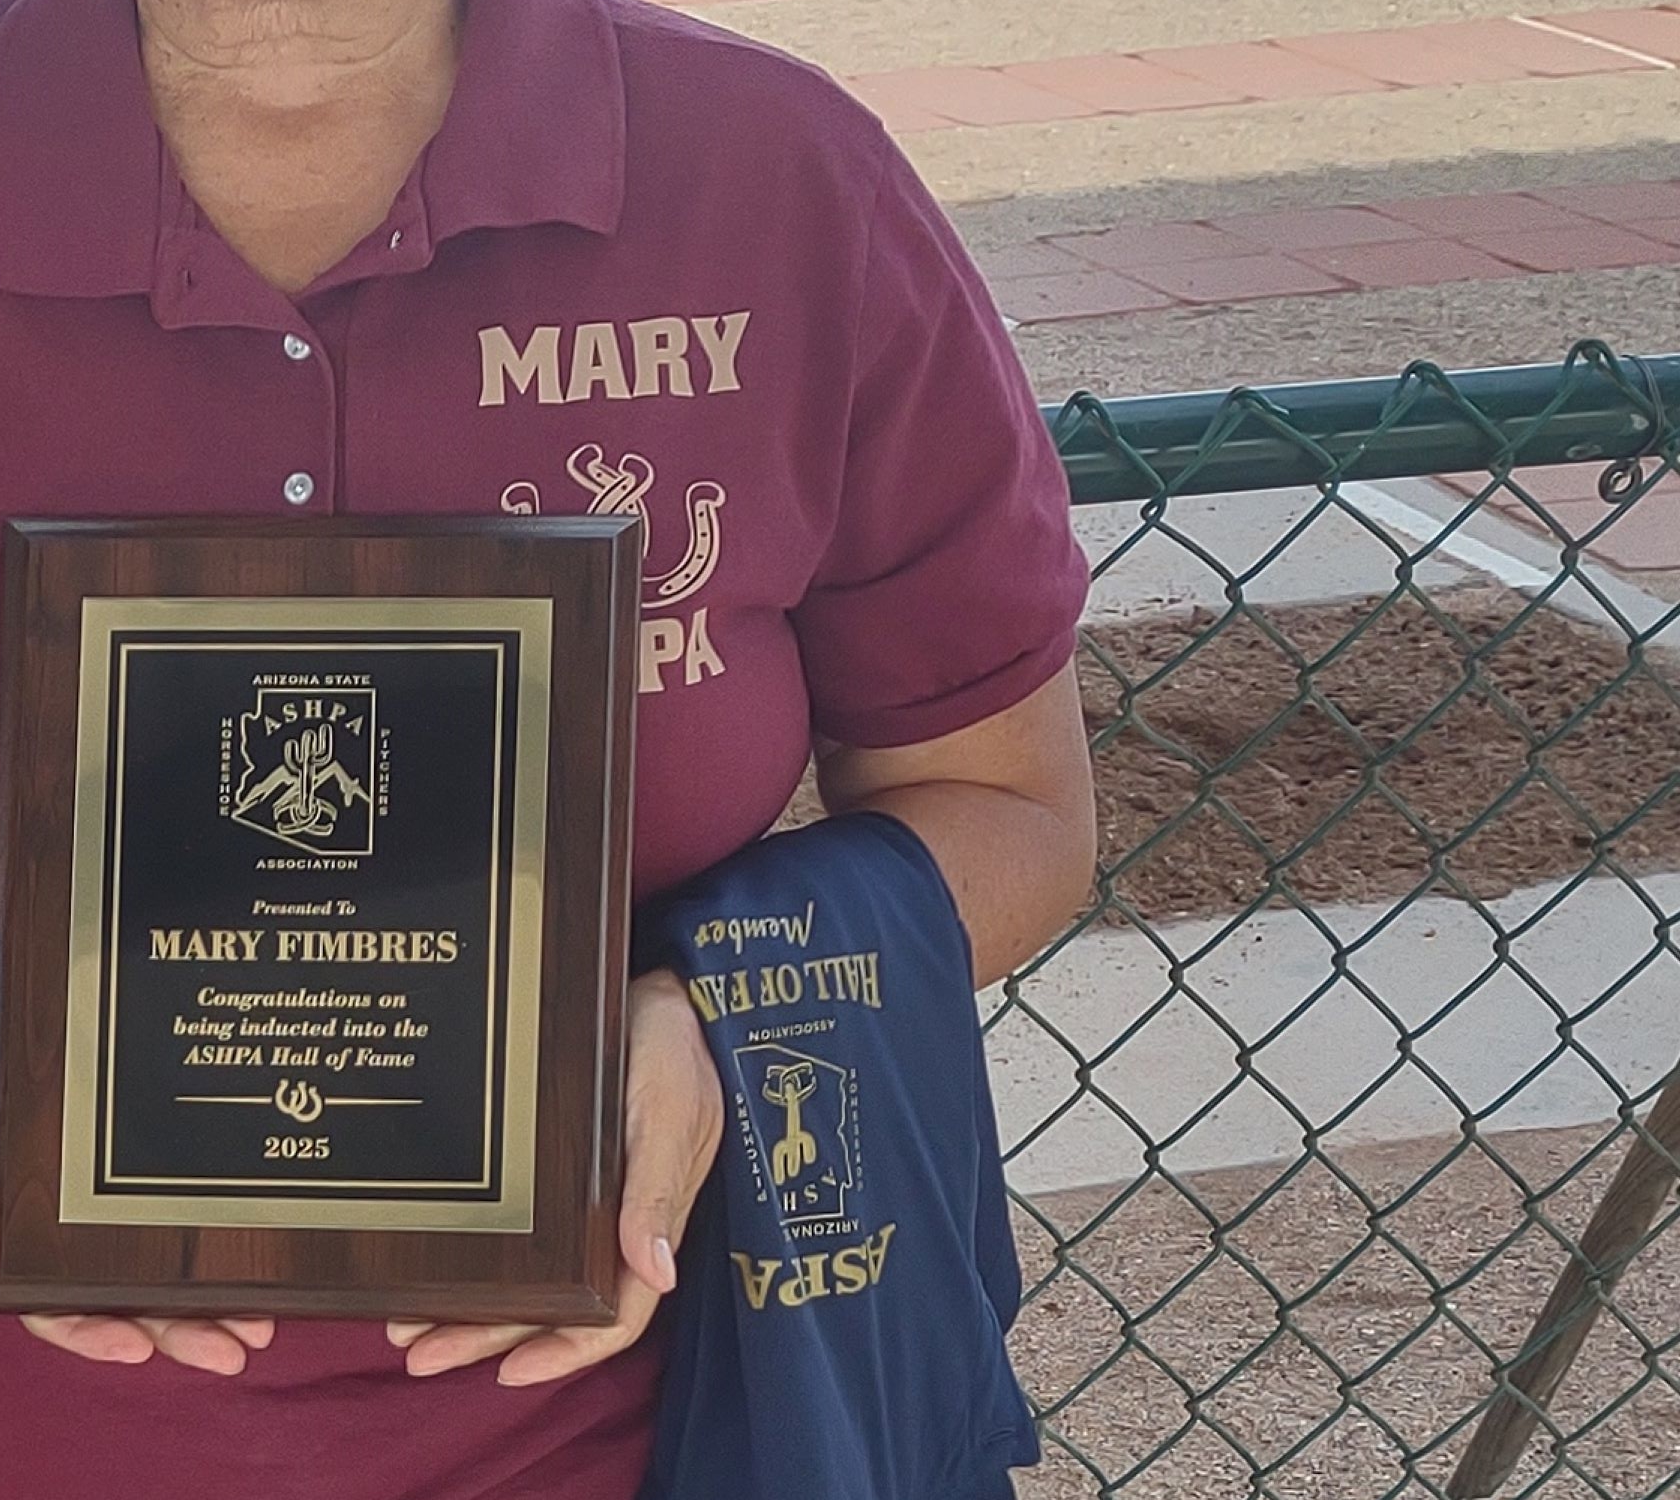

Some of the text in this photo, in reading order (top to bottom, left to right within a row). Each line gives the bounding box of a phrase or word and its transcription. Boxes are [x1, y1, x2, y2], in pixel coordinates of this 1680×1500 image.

[478, 311, 751, 407] MARY
[252, 674, 371, 686] ARIZONA STATE
[264, 699, 364, 736] ASHPA
[220, 717, 233, 817] HORSESHOE
[379, 728, 391, 816] PITCHERS
[256, 858, 359, 869] ASSOCIATION
[252, 900, 356, 916] Presented To
[694, 901, 815, 953] Member
[148, 928, 458, 963] MARY FIMBRES
[760, 964, 802, 1008] OF
[806, 952, 881, 1009] HALL
[197, 987, 407, 1012] Congratulations on
[172, 1016, 429, 1040] being inducted into the
[748, 1017, 836, 1043] ASSOCIATION
[182, 1046, 416, 1071] ASHPA Hall of Fame
[264, 1136, 331, 1160] 2025
